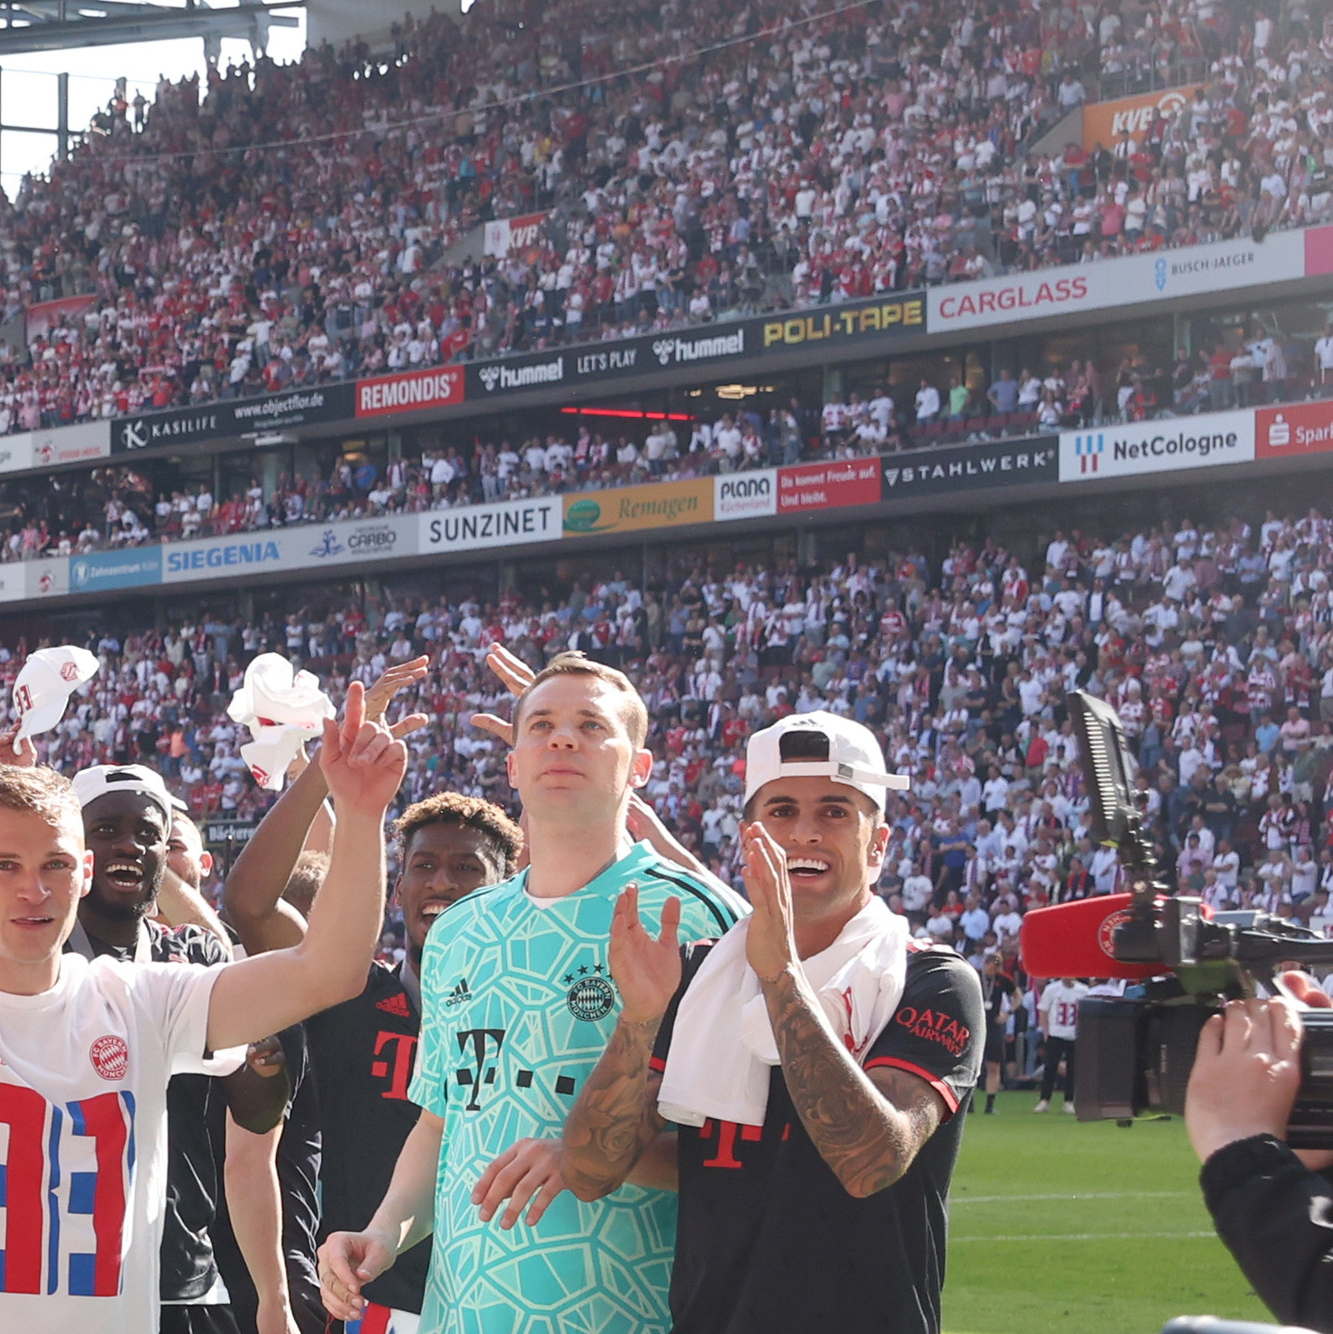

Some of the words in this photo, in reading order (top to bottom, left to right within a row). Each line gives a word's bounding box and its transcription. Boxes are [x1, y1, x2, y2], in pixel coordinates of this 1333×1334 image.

[1171, 253, 1254, 275] BUSCH-JAEGER
[940, 277, 1088, 319] CARGLASS
[609, 349, 636, 369] PLAY
[675, 329, 743, 362] hummel
[501, 356, 563, 388] hummel
[361, 377, 450, 411] REMONDIS
[152, 415, 217, 438] KASILIFE
[1296, 421, 1333, 448] Spar
[1114, 431, 1237, 462] NetCologne
[902, 449, 1047, 483] STAHLWERK
[619, 496, 698, 520] Remagen
[430, 507, 551, 544] SUNZINET
[168, 541, 280, 574] SIEGENIA
[896, 1006, 969, 1048] QATAR
[909, 1025, 962, 1058] AIRWAYS
